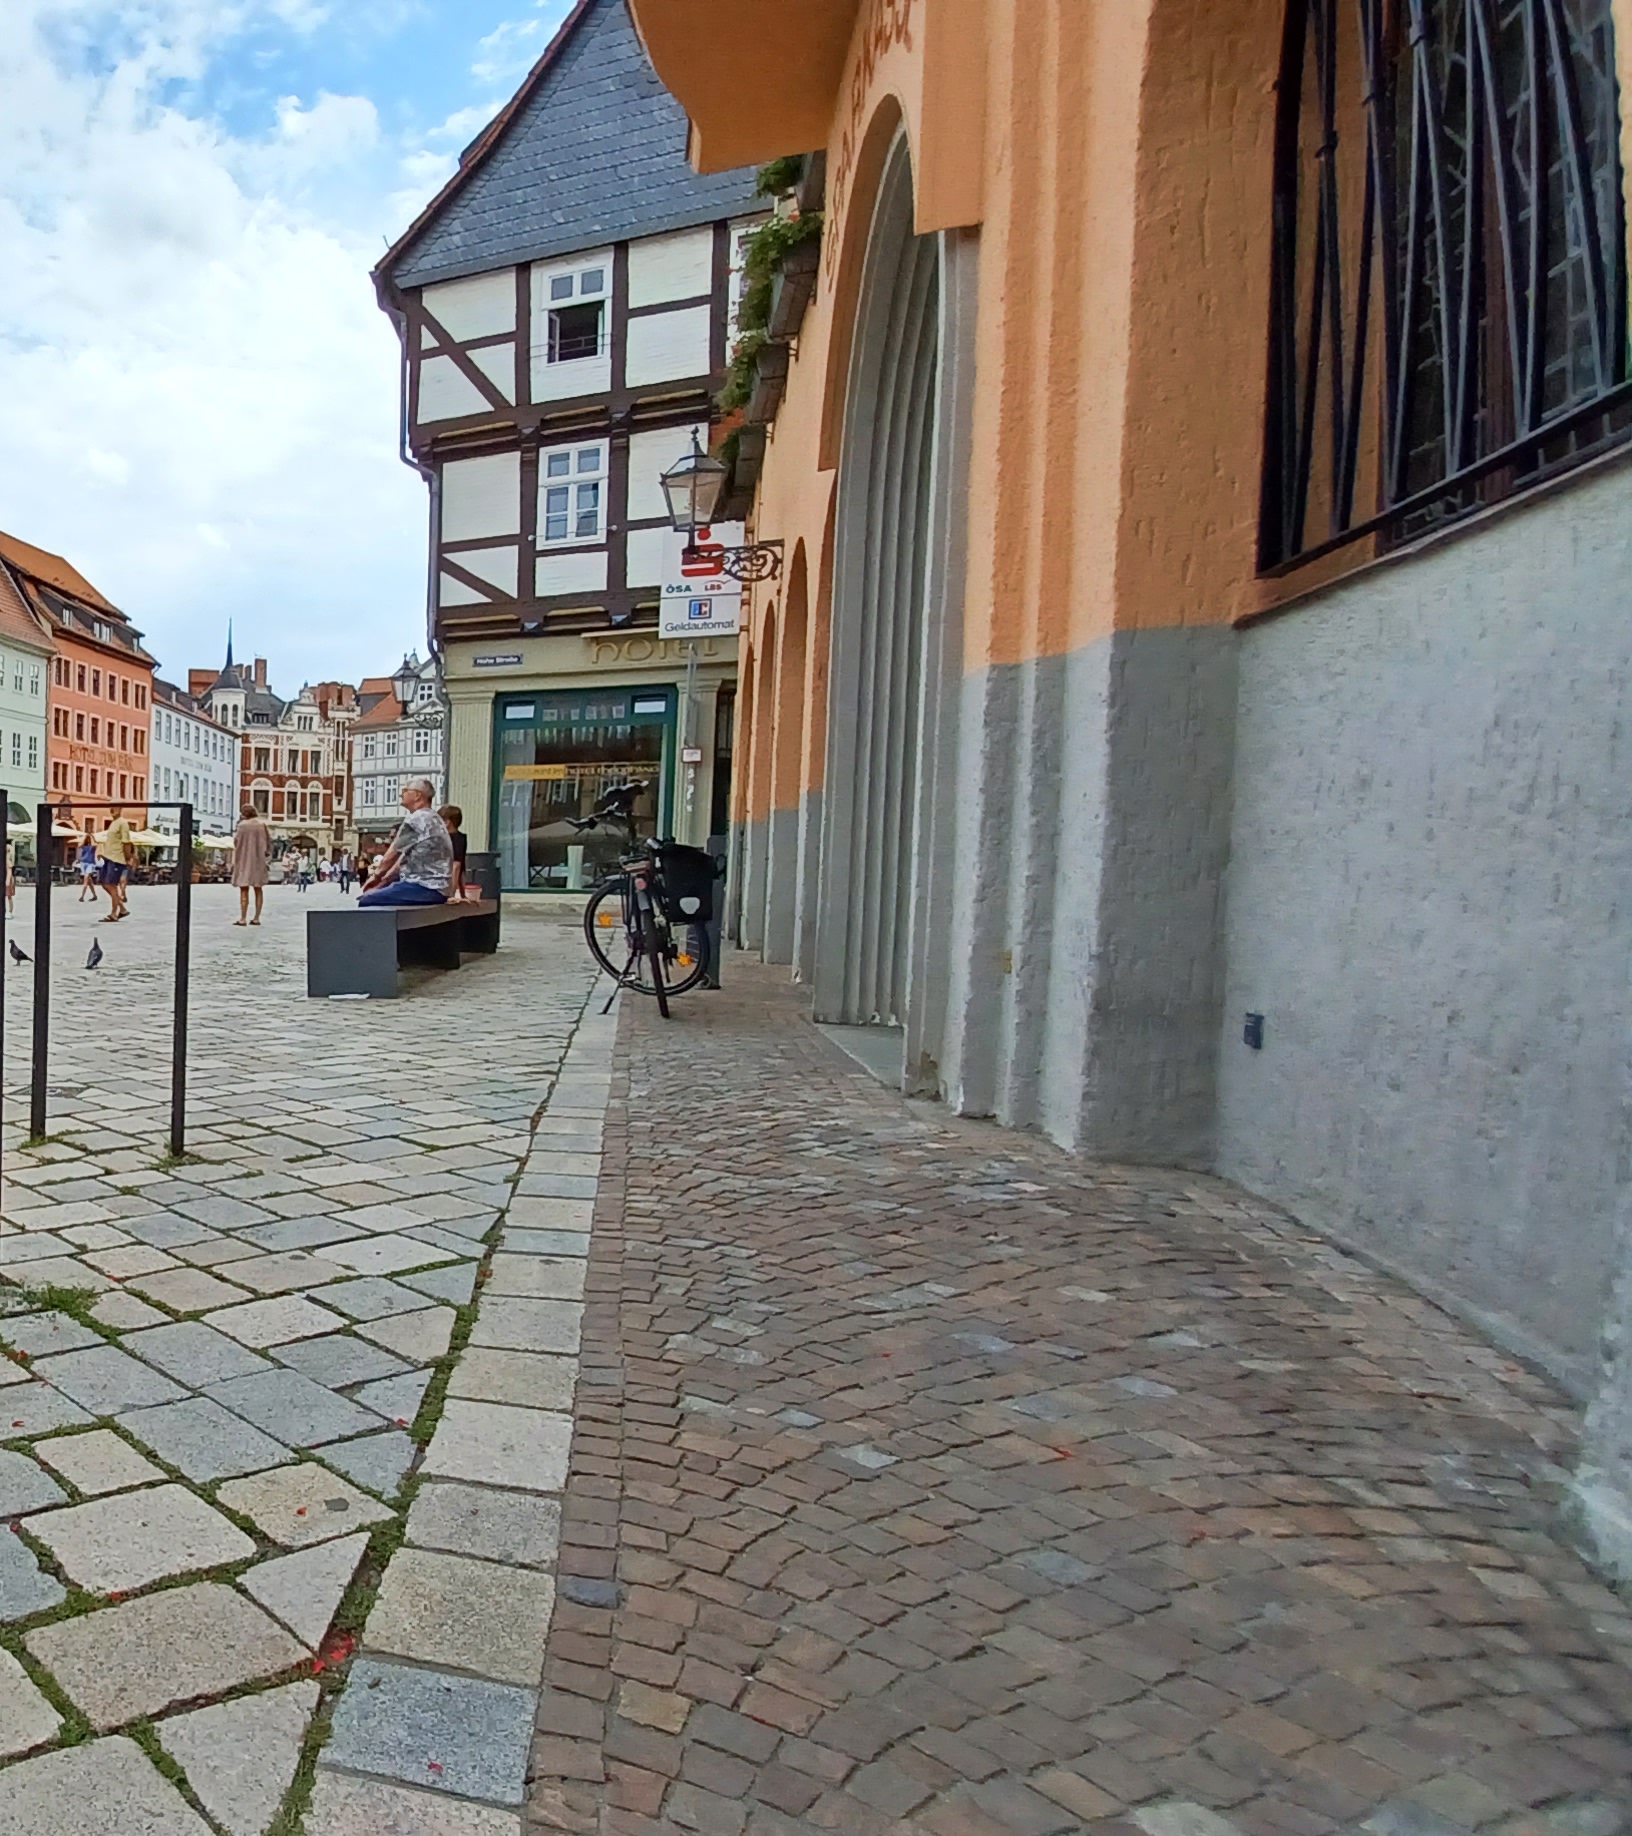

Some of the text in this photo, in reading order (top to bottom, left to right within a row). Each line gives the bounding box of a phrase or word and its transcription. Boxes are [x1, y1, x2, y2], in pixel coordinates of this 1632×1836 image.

[666, 584, 723, 594] ÖSA LBS
[664, 619, 735, 633] Geldautomat
[69, 744, 98, 765] HOTEL
